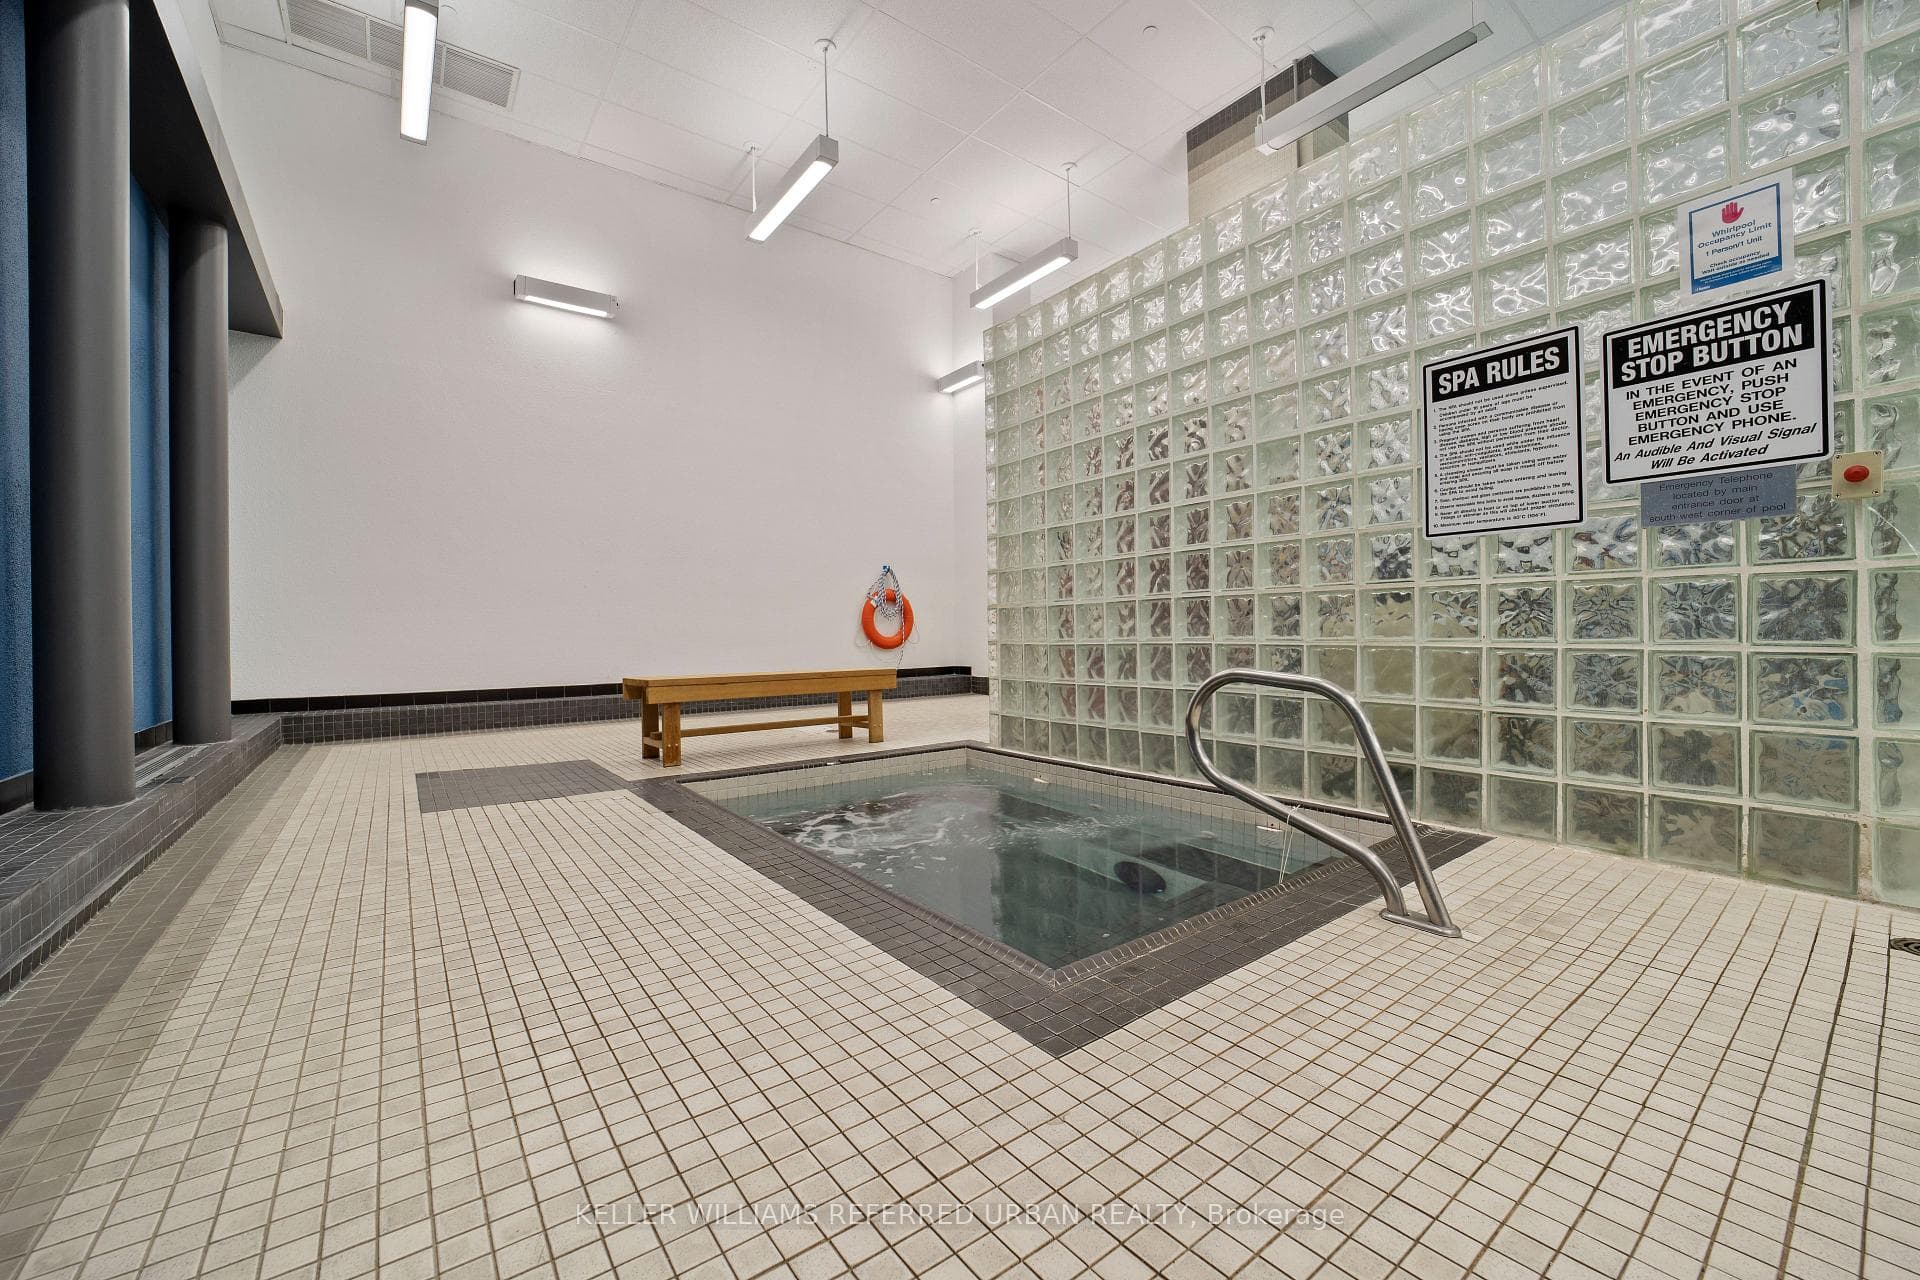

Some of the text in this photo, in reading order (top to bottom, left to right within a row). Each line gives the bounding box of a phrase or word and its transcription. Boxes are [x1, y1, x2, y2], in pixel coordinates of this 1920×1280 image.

[1697, 222, 1772, 249] Occupancy Limit
[1712, 219, 1756, 237] Whirlpool
[1711, 241, 1744, 255] Person/1
[1628, 300, 1791, 359] EMERGENCY
[1621, 323, 1802, 382] STOP BUTTON
[1438, 346, 1560, 395] SPA RULES
[1626, 358, 1797, 400] IN THE EVENT OF AN
[1633, 372, 1789, 410] EMERGENCY, PUSH
[1635, 386, 1786, 422] EMERGENCY STOP
[1629, 411, 1796, 446] EMERGENCY PHONE.
[1638, 399, 1783, 433] BUTTON AND USE
[1614, 422, 1817, 462] An Audible And Visual Signal
[1651, 444, 1770, 469] Will Be Activated
[1659, 472, 1773, 491] Emergency Telephone
[1673, 485, 1758, 499] located by main
[1671, 495, 1759, 510] entrance door at
[1707, 508, 1742, 517] corner
[1746, 505, 1756, 514] of
[1762, 502, 1786, 513] pool
